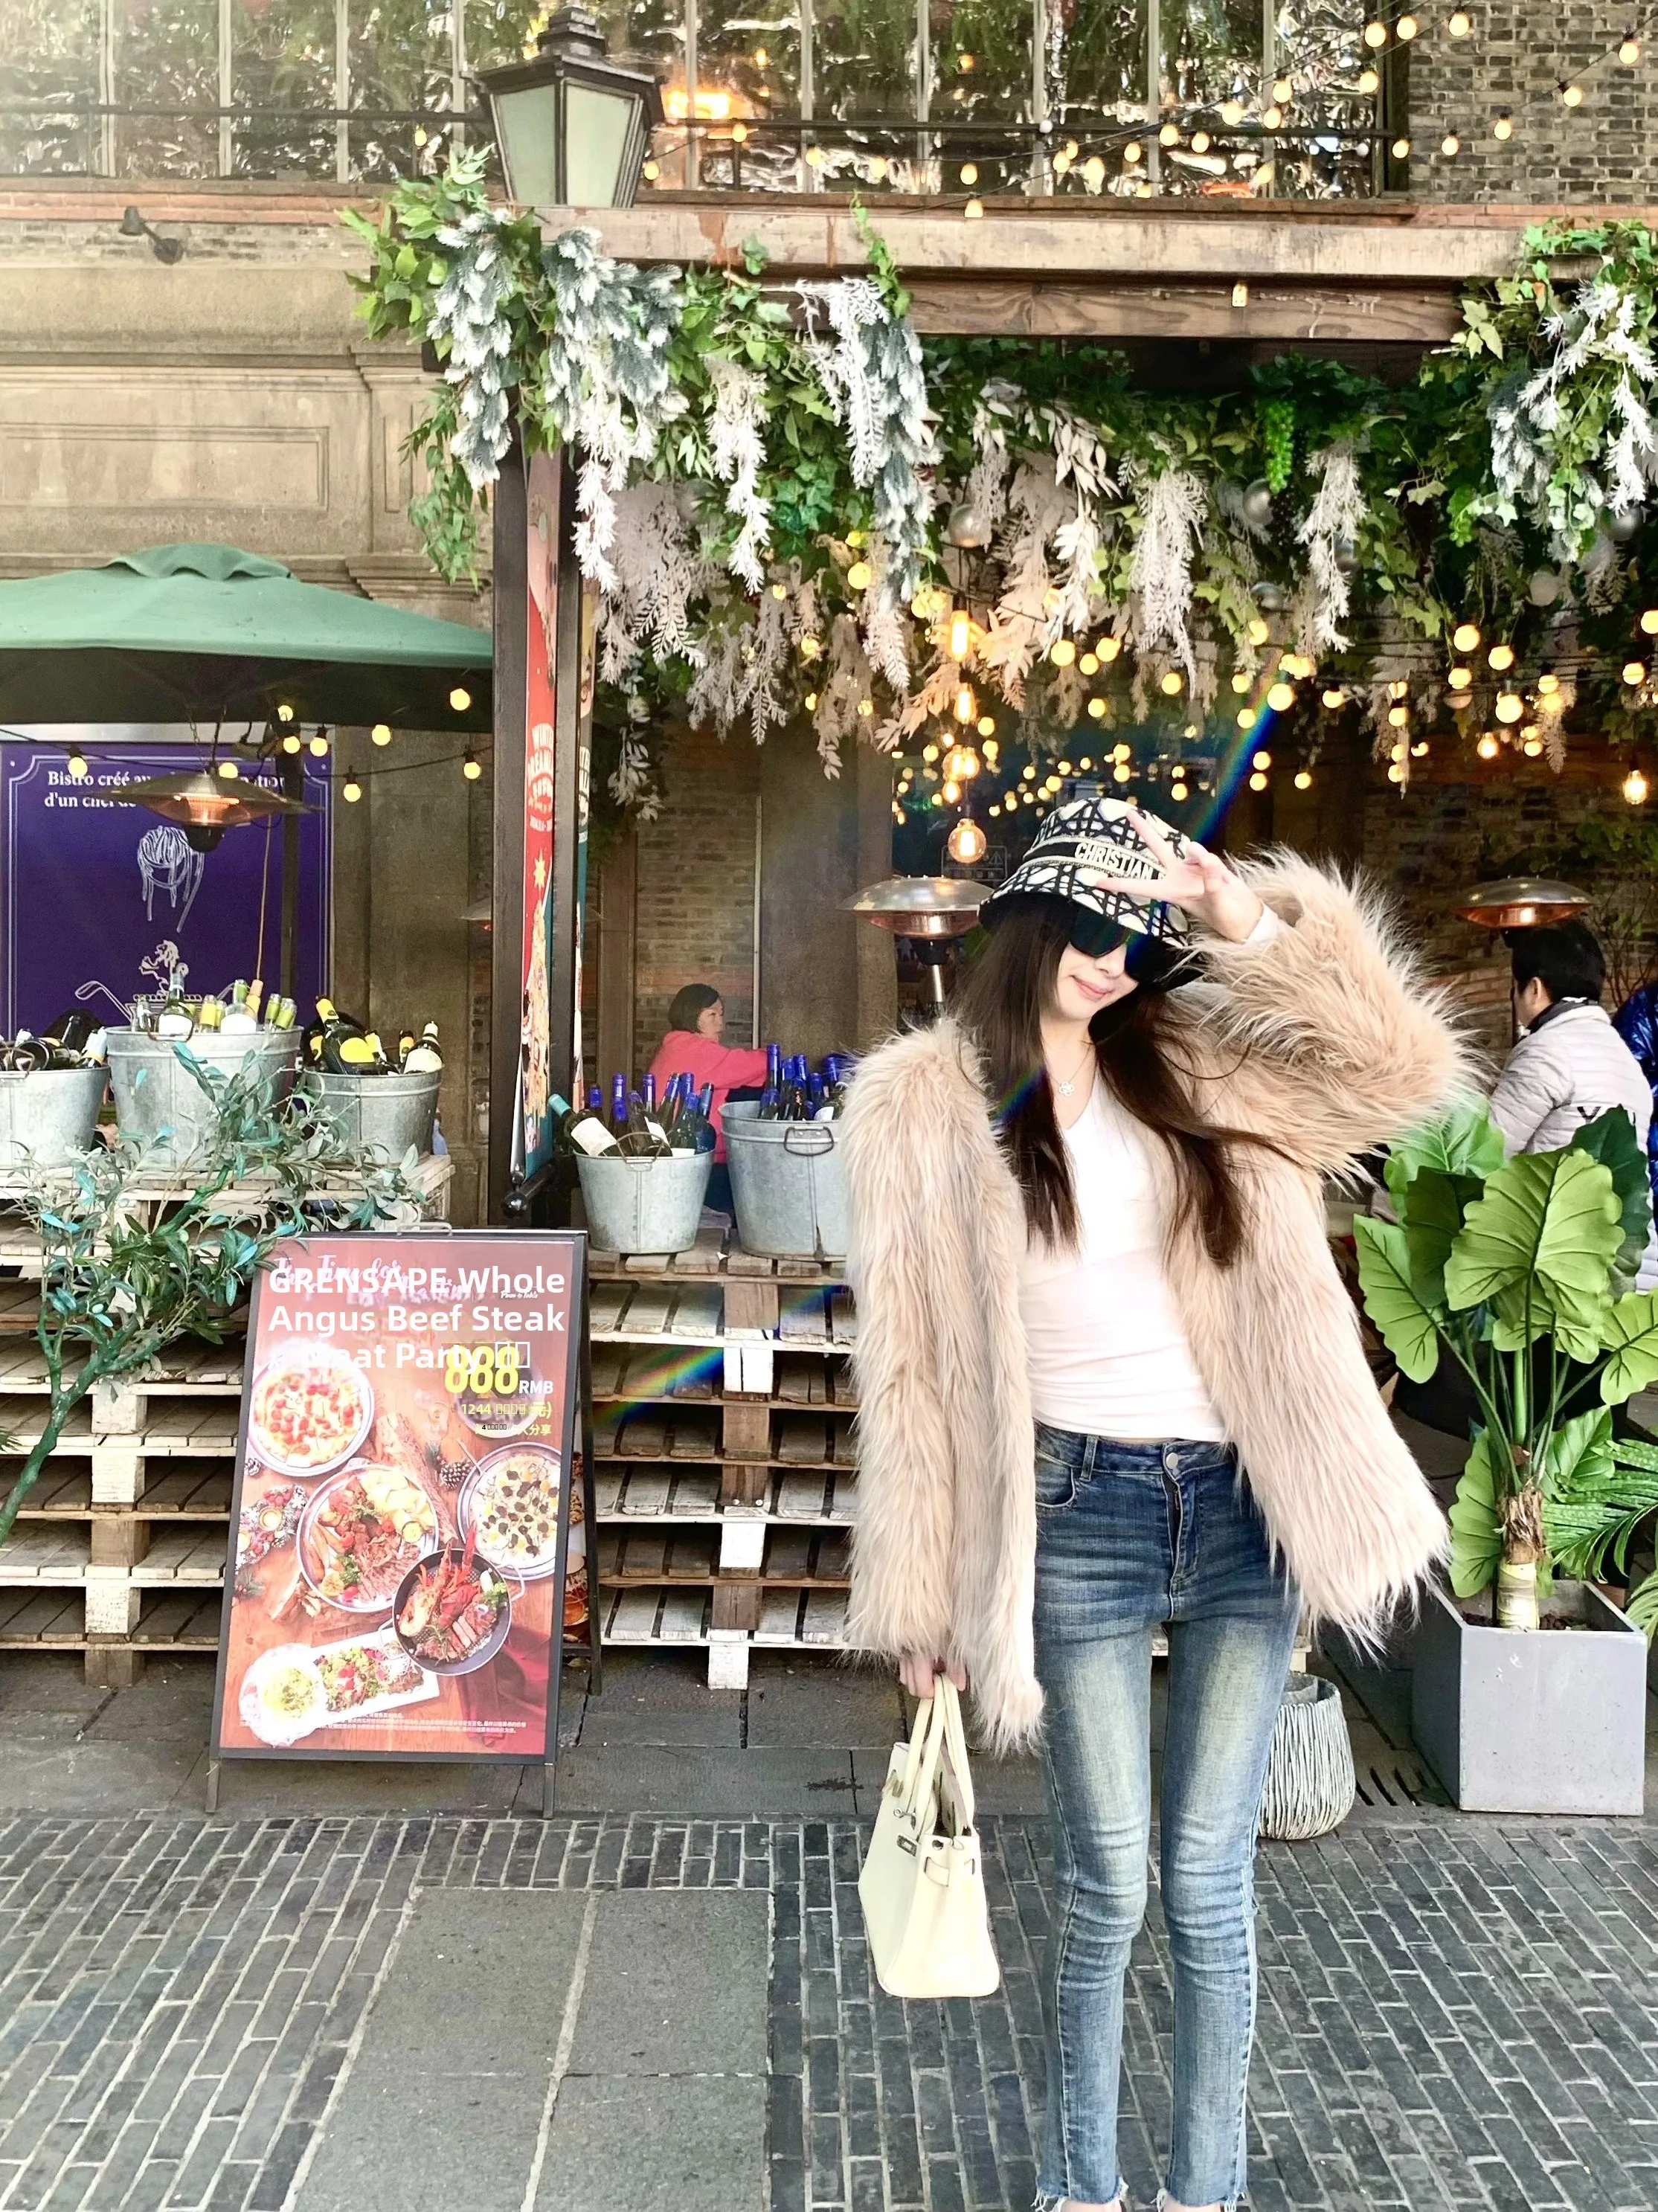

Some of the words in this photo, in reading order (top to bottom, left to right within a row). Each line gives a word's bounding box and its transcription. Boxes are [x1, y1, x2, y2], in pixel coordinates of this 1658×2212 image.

[48, 771, 94, 786] Bistro
[97, 771, 130, 786] créé
[44, 791, 78, 808] d'un
[1074, 842, 1154, 880] CHRISTIAN
[444, 1345, 520, 1395] 888
[518, 1380, 554, 1395] RMB
